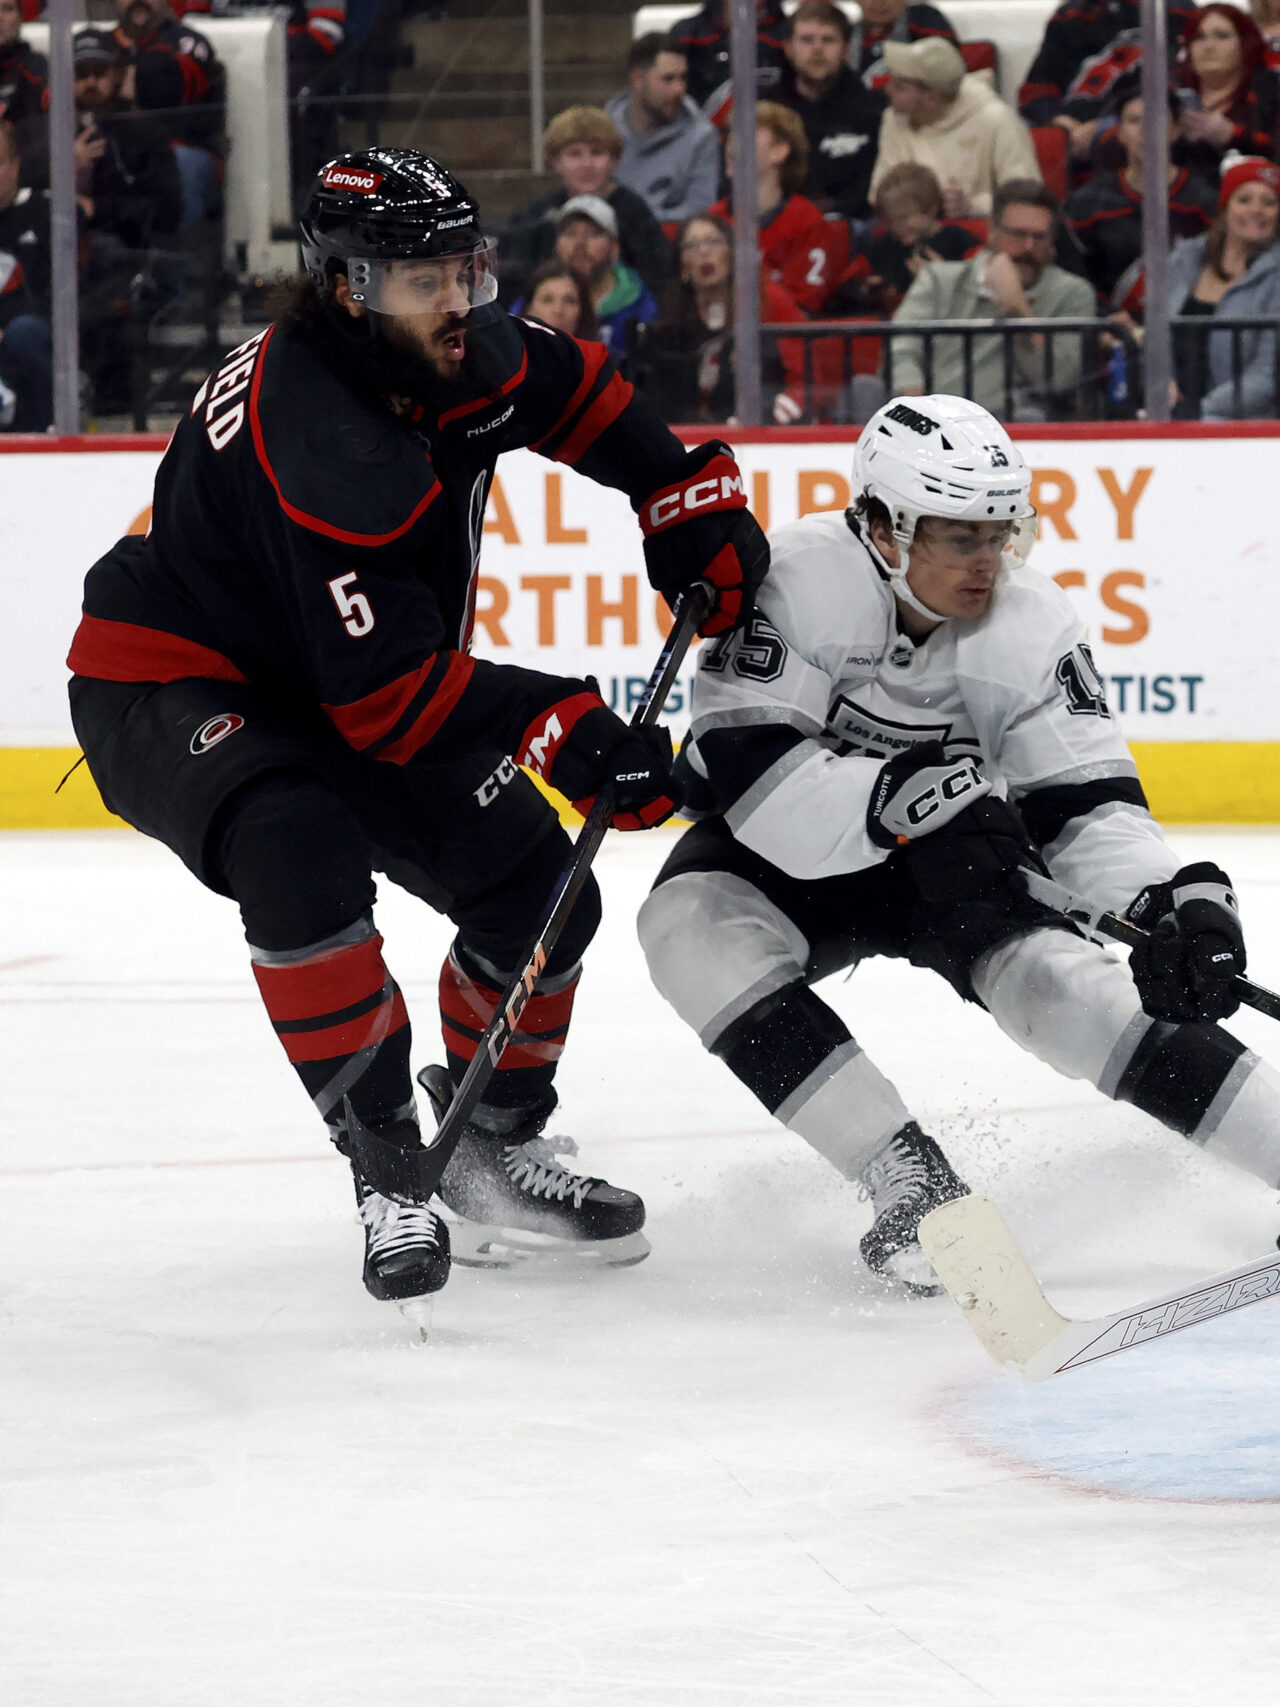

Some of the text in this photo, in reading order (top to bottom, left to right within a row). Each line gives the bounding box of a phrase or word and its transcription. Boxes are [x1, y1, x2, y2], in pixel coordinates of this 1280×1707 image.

[325, 169, 375, 189] Lenovo
[467, 404, 515, 438] NUCOR
[649, 475, 744, 528] CCM
[326, 569, 376, 639] 5
[700, 617, 788, 684] 15
[843, 719, 870, 740] Los
[615, 770, 650, 782] CCM
[873, 774, 892, 818] TURCOTTE
[488, 940, 547, 1068] CCM
